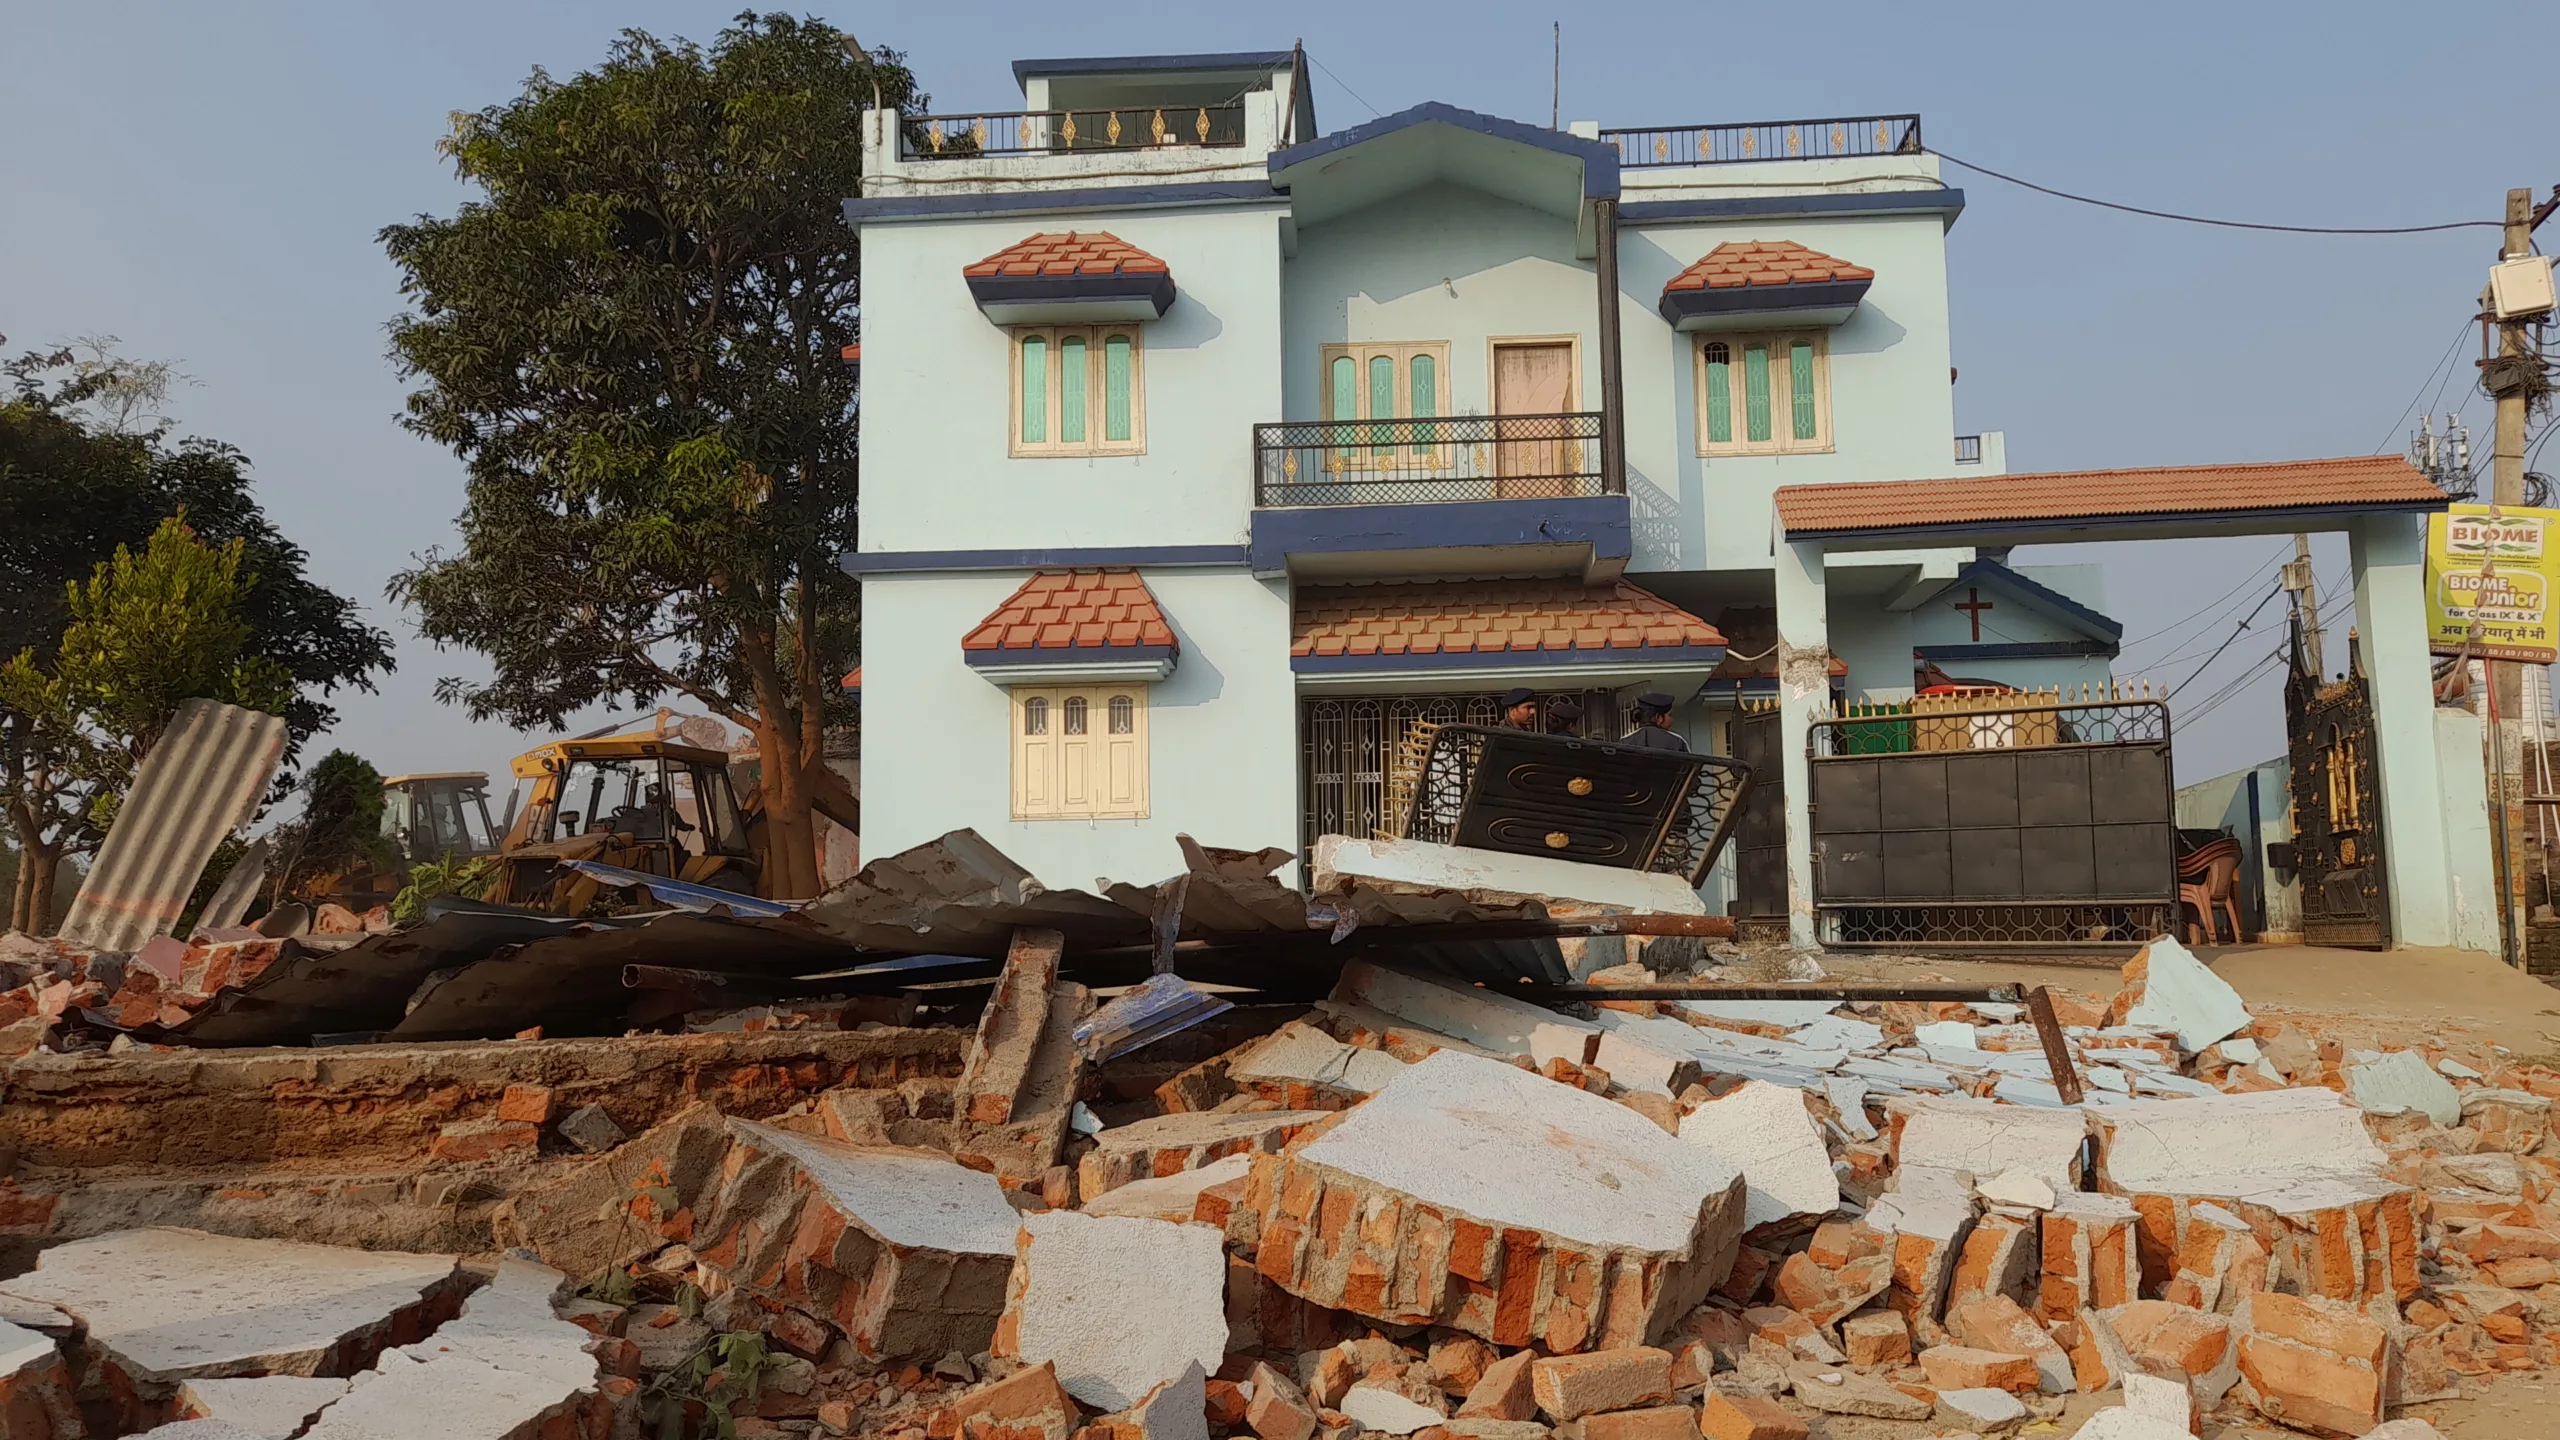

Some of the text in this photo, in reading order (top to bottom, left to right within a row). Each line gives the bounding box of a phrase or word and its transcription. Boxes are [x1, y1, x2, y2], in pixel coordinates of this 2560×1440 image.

[2452, 527, 2538, 543] BIOME
[2449, 575, 2509, 590] BIOME
[2475, 586, 2539, 608] unior
[2449, 609, 2464, 617] for
[2468, 610, 2497, 618] Cass
[2516, 612, 2524, 620] &
[2441, 625, 2463, 635] अब
[2516, 626, 2527, 639] में
[2529, 627, 2545, 640] भी
